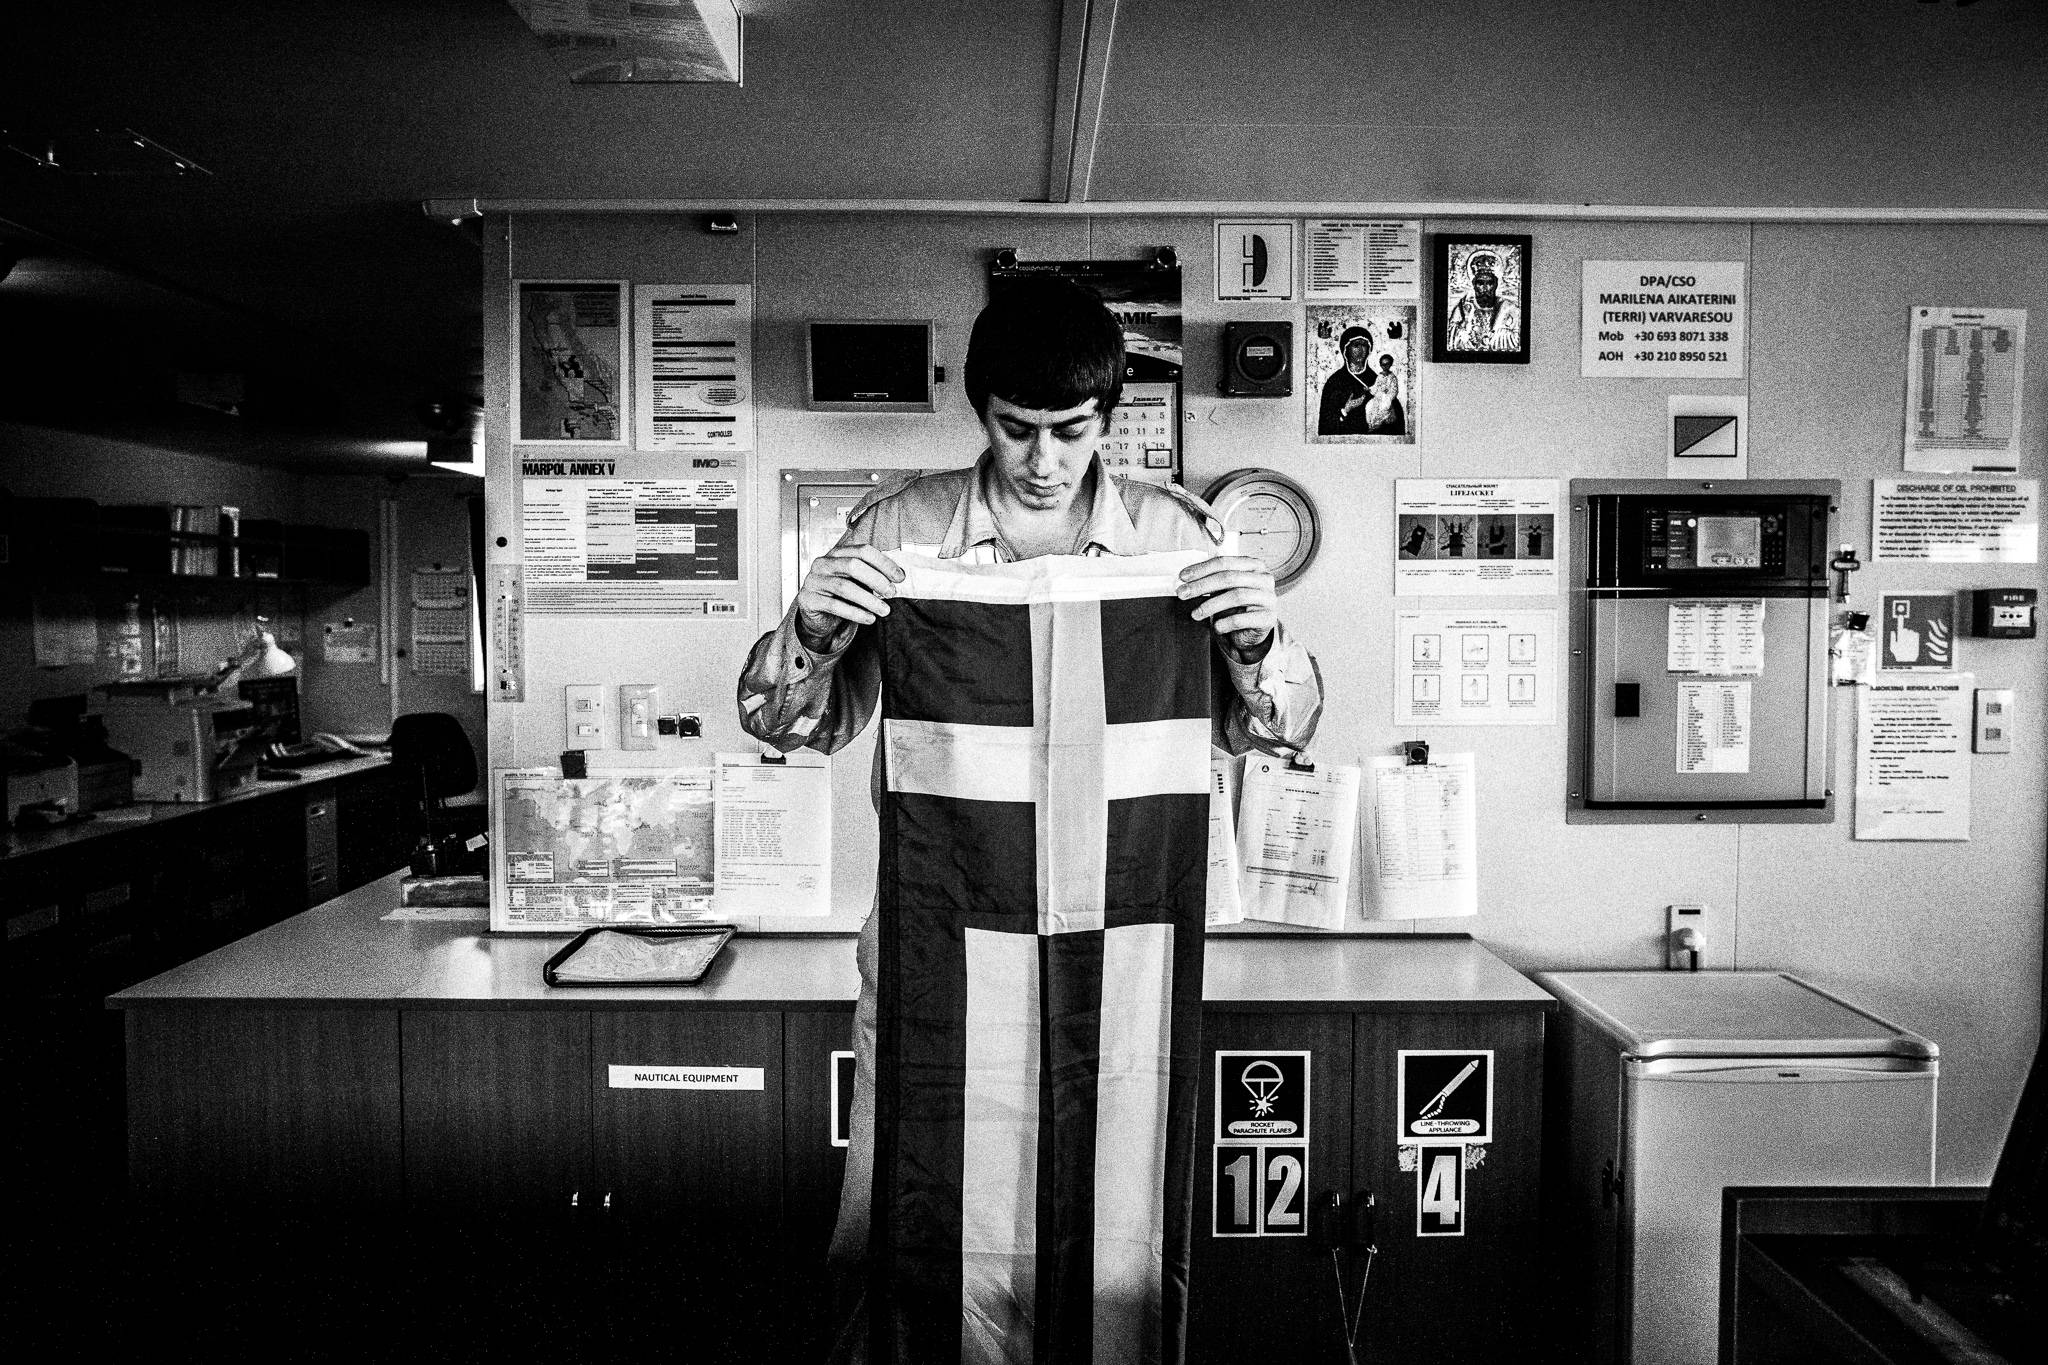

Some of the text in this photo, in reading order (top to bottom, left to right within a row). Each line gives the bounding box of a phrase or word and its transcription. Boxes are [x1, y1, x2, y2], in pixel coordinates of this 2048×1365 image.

[1640, 275, 1696, 288] DPA/CSO
[1599, 294, 1736, 305] MARILENA AIKATERINI
[1111, 311, 1158, 325] AMIC
[1603, 311, 1733, 324] (TERRI) VARVARESOU
[1598, 331, 1729, 342] Mob +30 693 8071 338
[1598, 351, 1728, 362] AOH +30 210 8950 521
[1126, 367, 1134, 376] e
[1123, 412, 1165, 420] 3 4 5
[707, 430, 733, 438] CONTROLLED
[1119, 427, 1165, 435] 10 11 12
[1101, 443, 1111, 451] 16
[692, 459, 720, 469] IMO
[1118, 457, 1129, 465] 24
[1155, 457, 1165, 465] 26
[522, 463, 616, 476] MARPOL ANNEX V
[1896, 484, 2017, 493] DISCHARGE OF OIL PROHIBITED
[634, 1072, 740, 1083] NAUTICAL EQUIPMENT
[1422, 1155, 1460, 1225] 4
